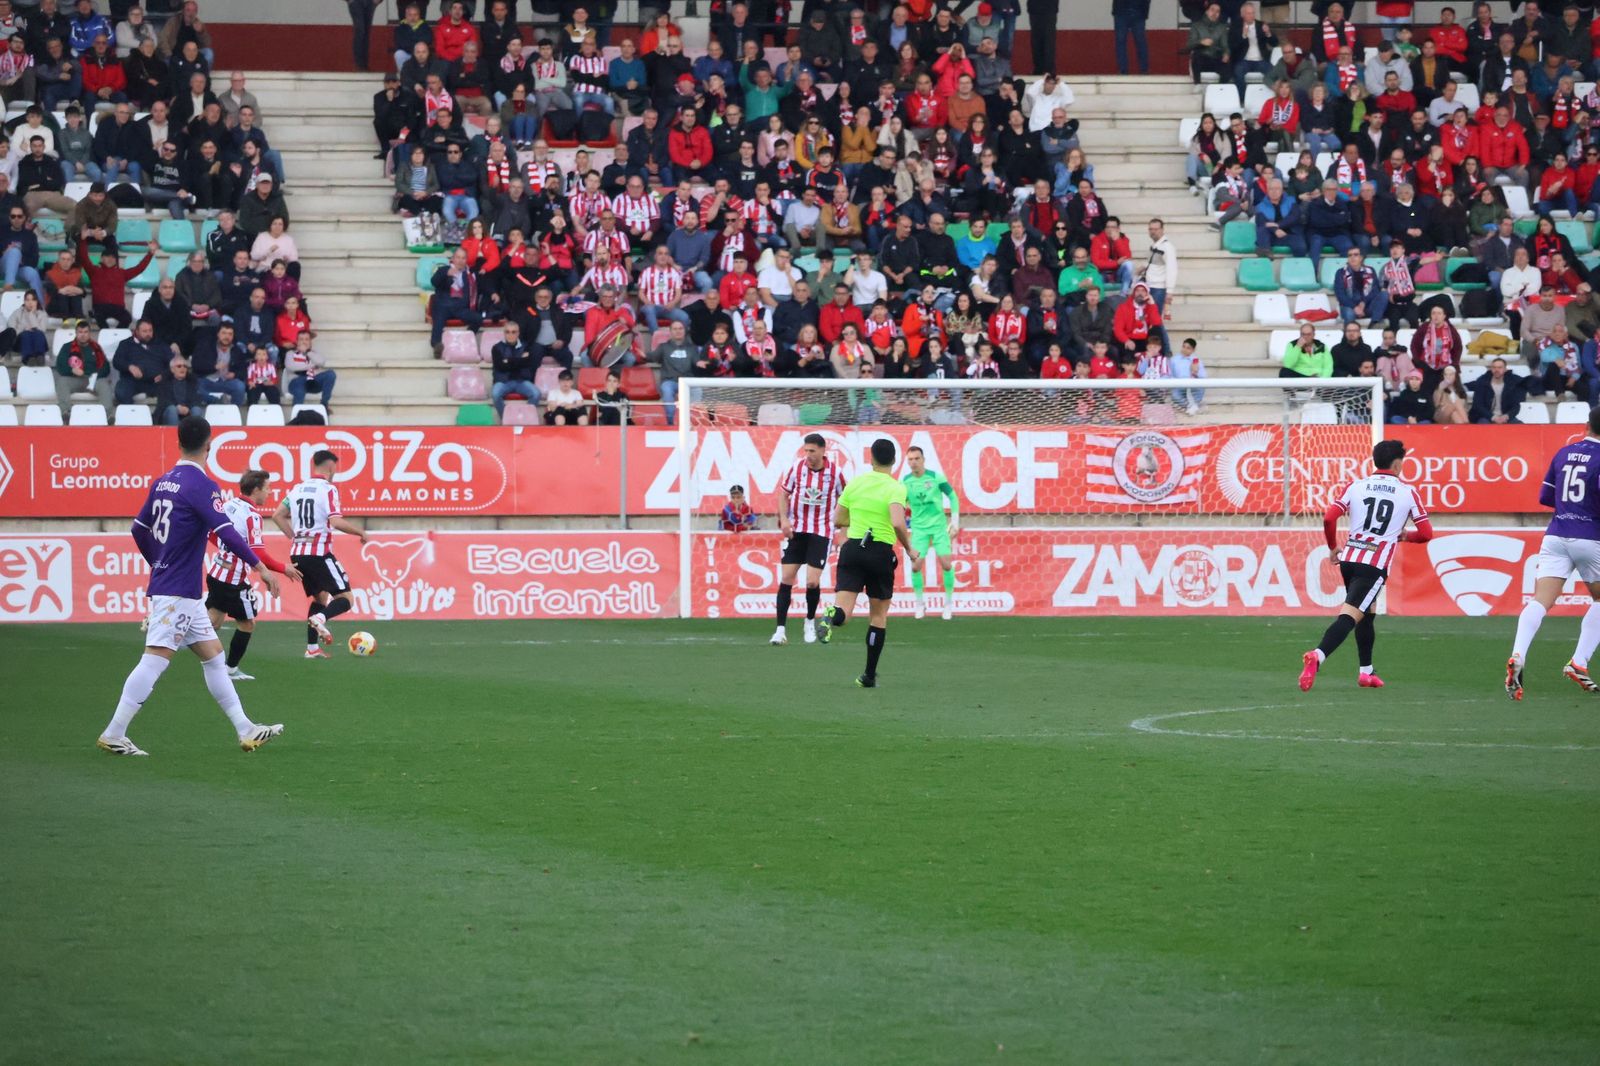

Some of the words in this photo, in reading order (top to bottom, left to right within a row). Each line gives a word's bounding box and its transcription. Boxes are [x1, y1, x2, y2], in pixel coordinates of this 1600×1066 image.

[1130, 435, 1165, 445] FONDO
[50, 454, 99, 471] Grupo
[962, 430, 1068, 509] CF
[51, 472, 152, 489] Leomotor
[350, 489, 359, 501] Y
[368, 488, 474, 501] JAMONES
[1306, 484, 1465, 508] ROTO
[1562, 465, 1587, 503] 15
[152, 499, 173, 544] 23
[296, 499, 315, 529] 10
[1363, 497, 1394, 536] 19
[468, 541, 659, 574] Escuela
[1052, 544, 1301, 607] ZAMORA
[1305, 544, 1347, 607] C
[473, 582, 661, 615] infantil
